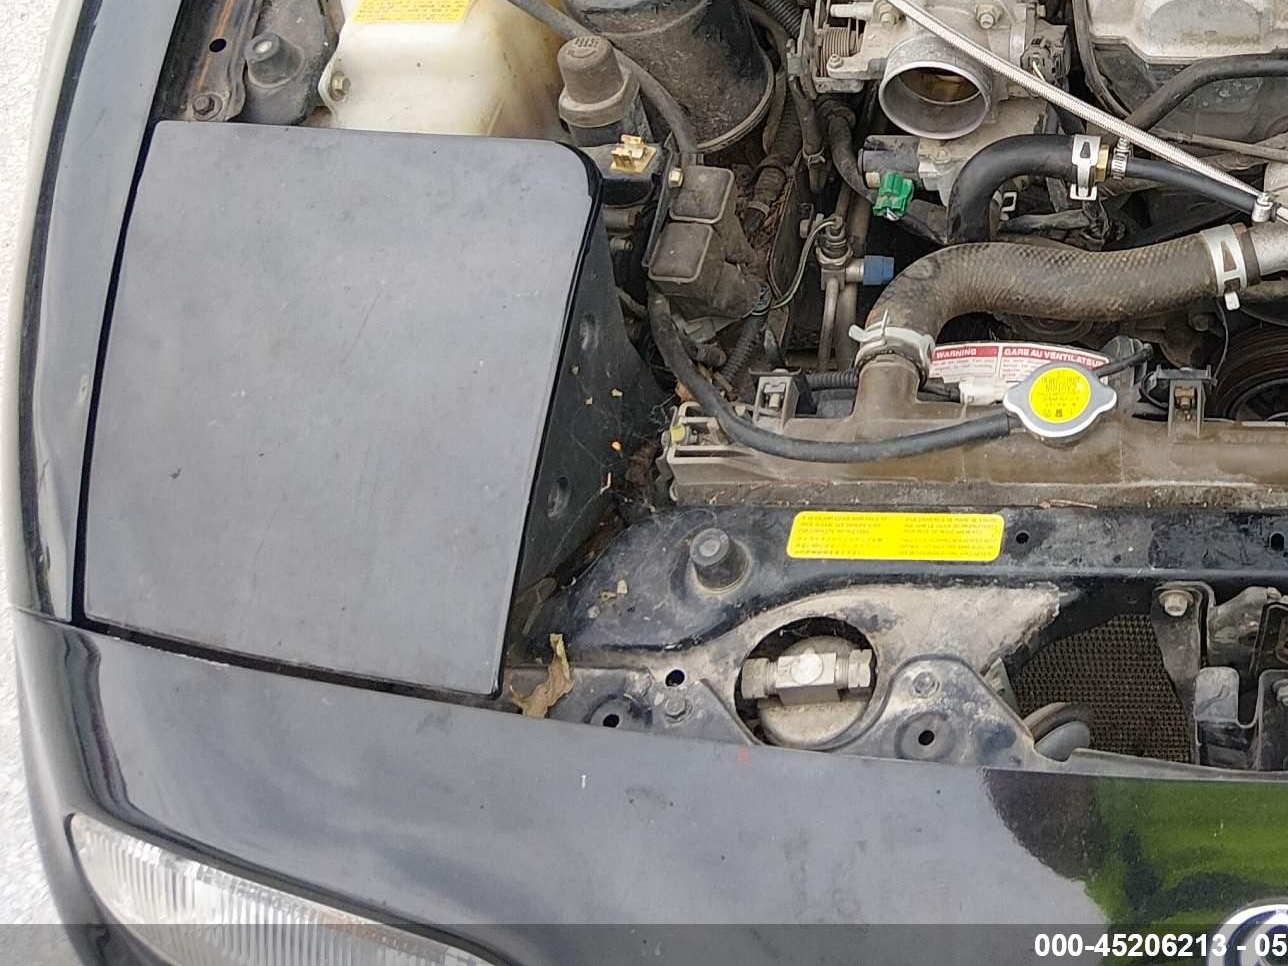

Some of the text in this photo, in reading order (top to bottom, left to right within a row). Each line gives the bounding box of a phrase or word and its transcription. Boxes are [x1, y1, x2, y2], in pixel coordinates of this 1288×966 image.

[936, 347, 977, 359] WARNING
[1004, 347, 1105, 367] GARE AU VENTILATEUR
